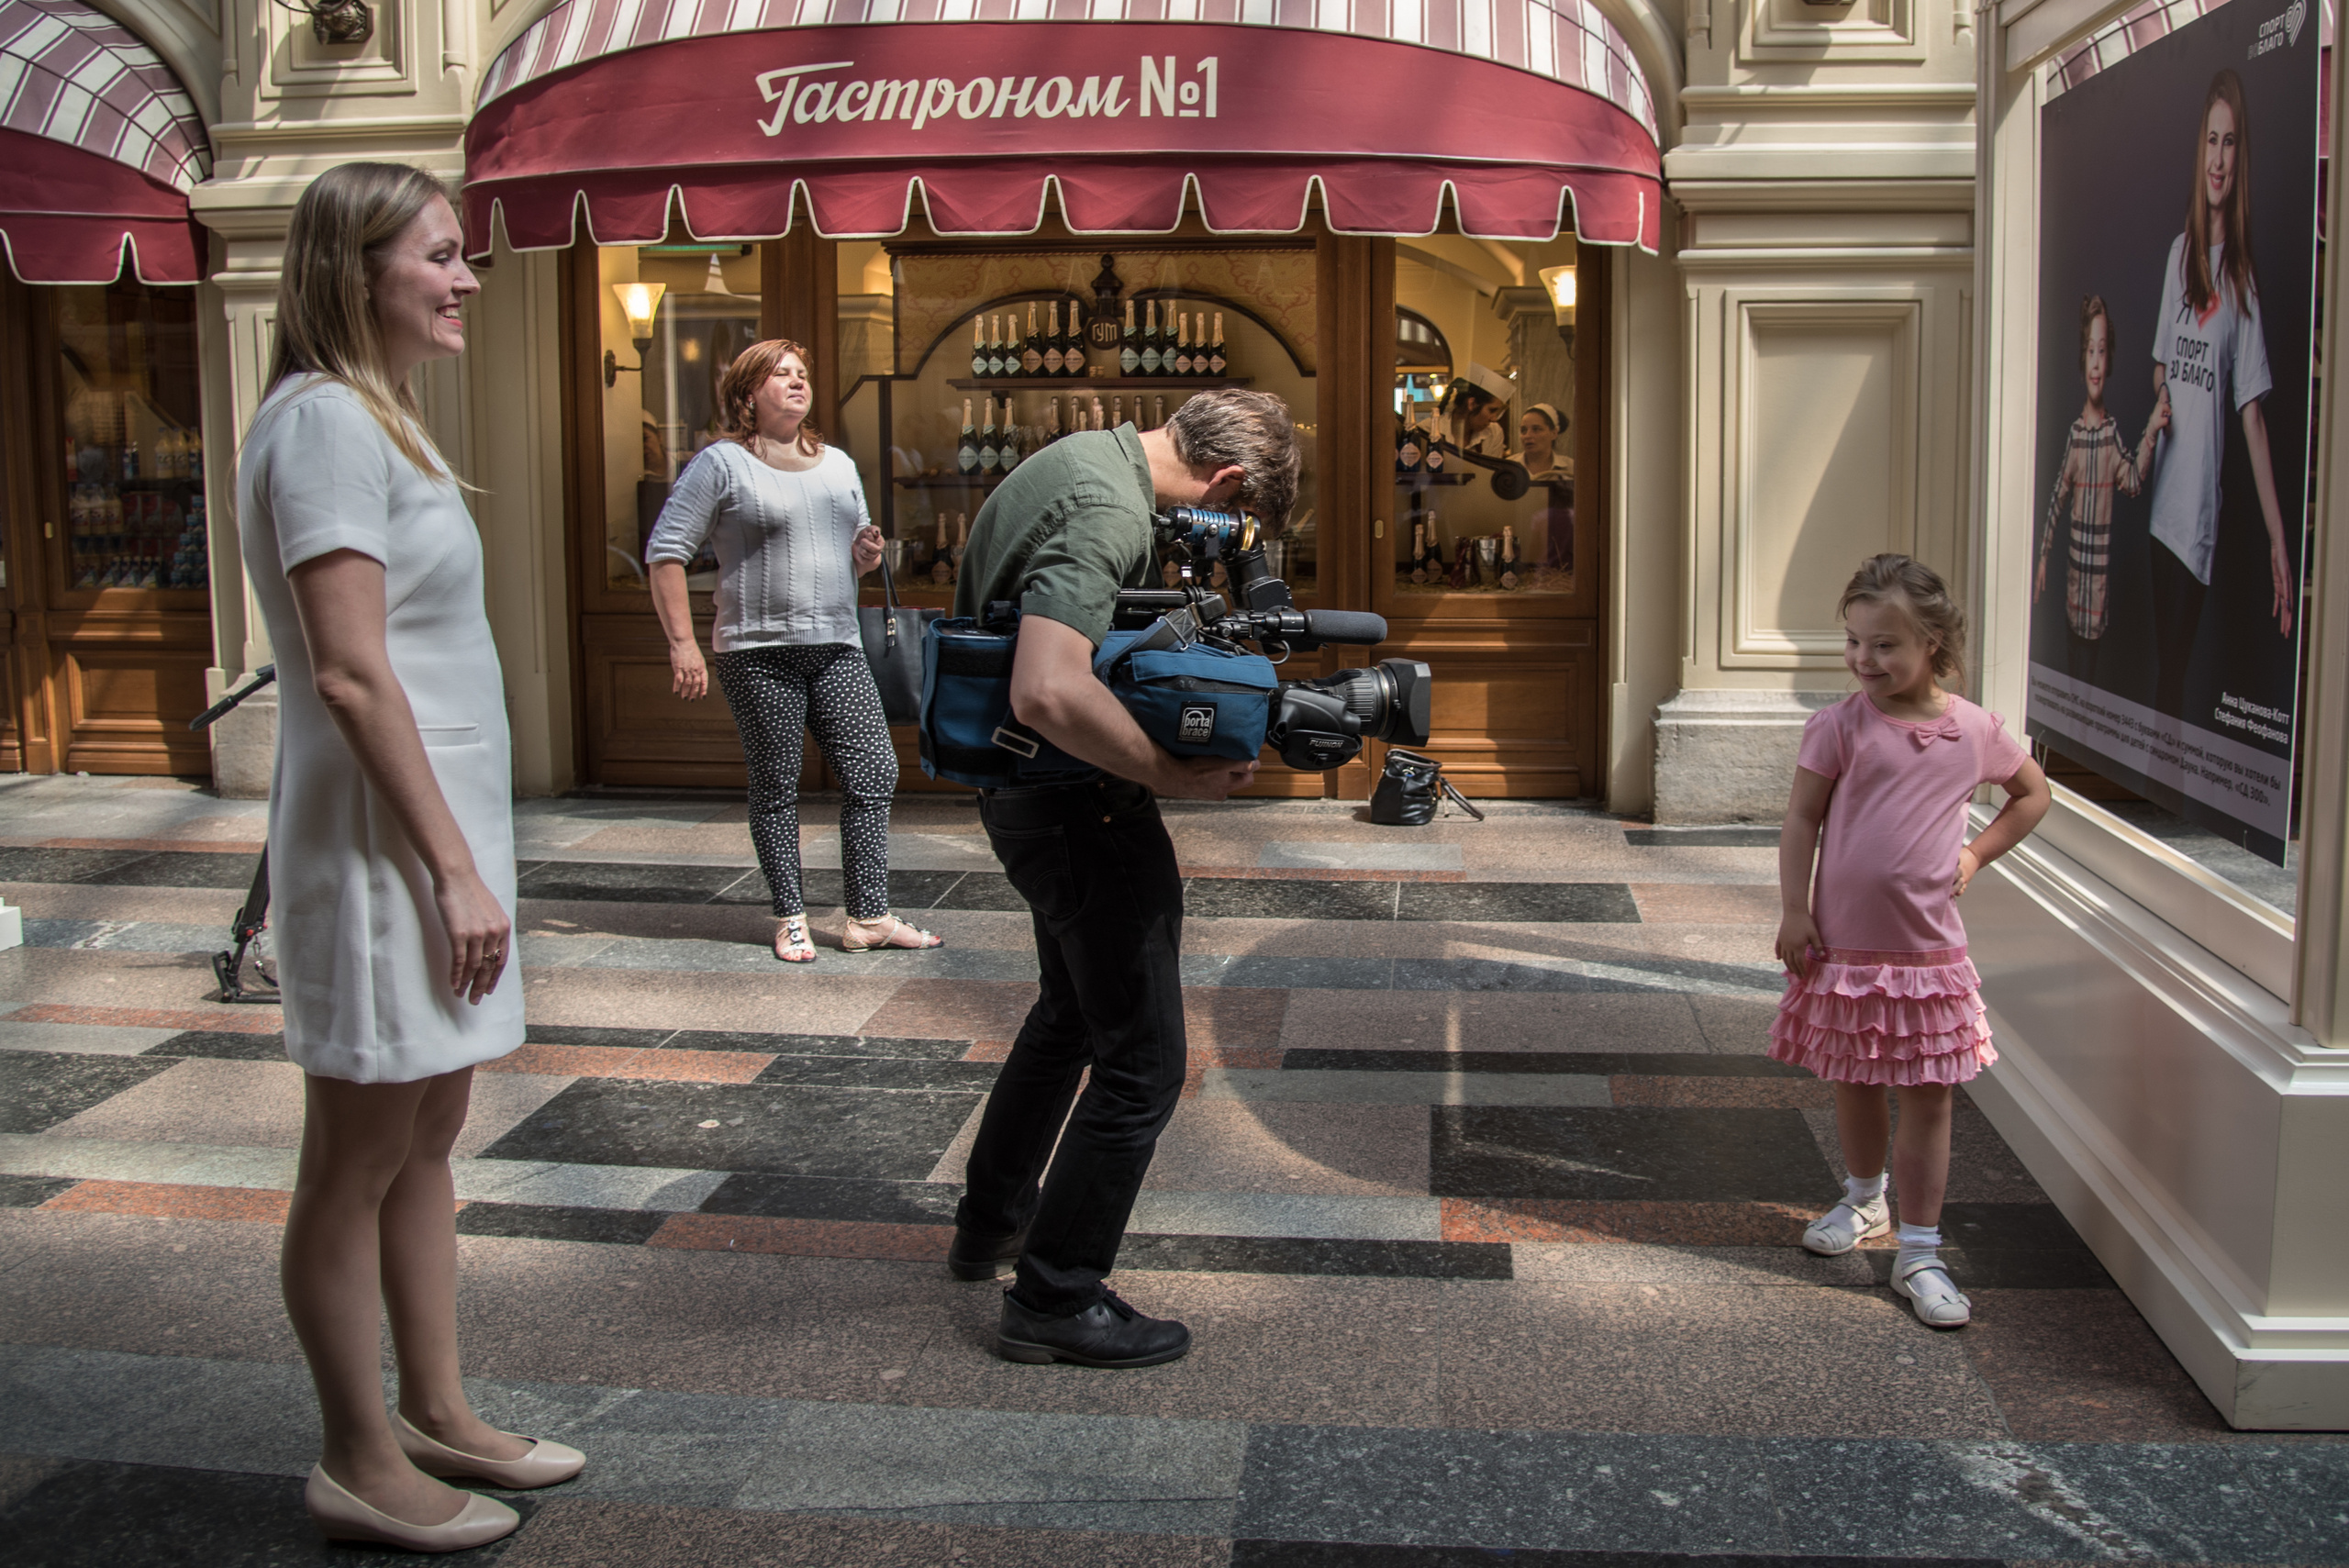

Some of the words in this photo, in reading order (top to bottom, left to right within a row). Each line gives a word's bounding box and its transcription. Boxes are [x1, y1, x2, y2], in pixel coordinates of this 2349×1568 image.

[2259, 13, 2286, 39] СПОРТ
[2257, 31, 2284, 56] БЛАГО
[756, 61, 1130, 137] Гастроном
[1139, 56, 1219, 118] №1
[2176, 335, 2210, 363] СПОРТ
[2180, 361, 2214, 393] БЛАГО
[2221, 691, 2239, 708] Анна
[1185, 715, 1211, 728] porta
[2214, 706, 2247, 729] Стефания
[1308, 740, 1343, 749] FUJINON
